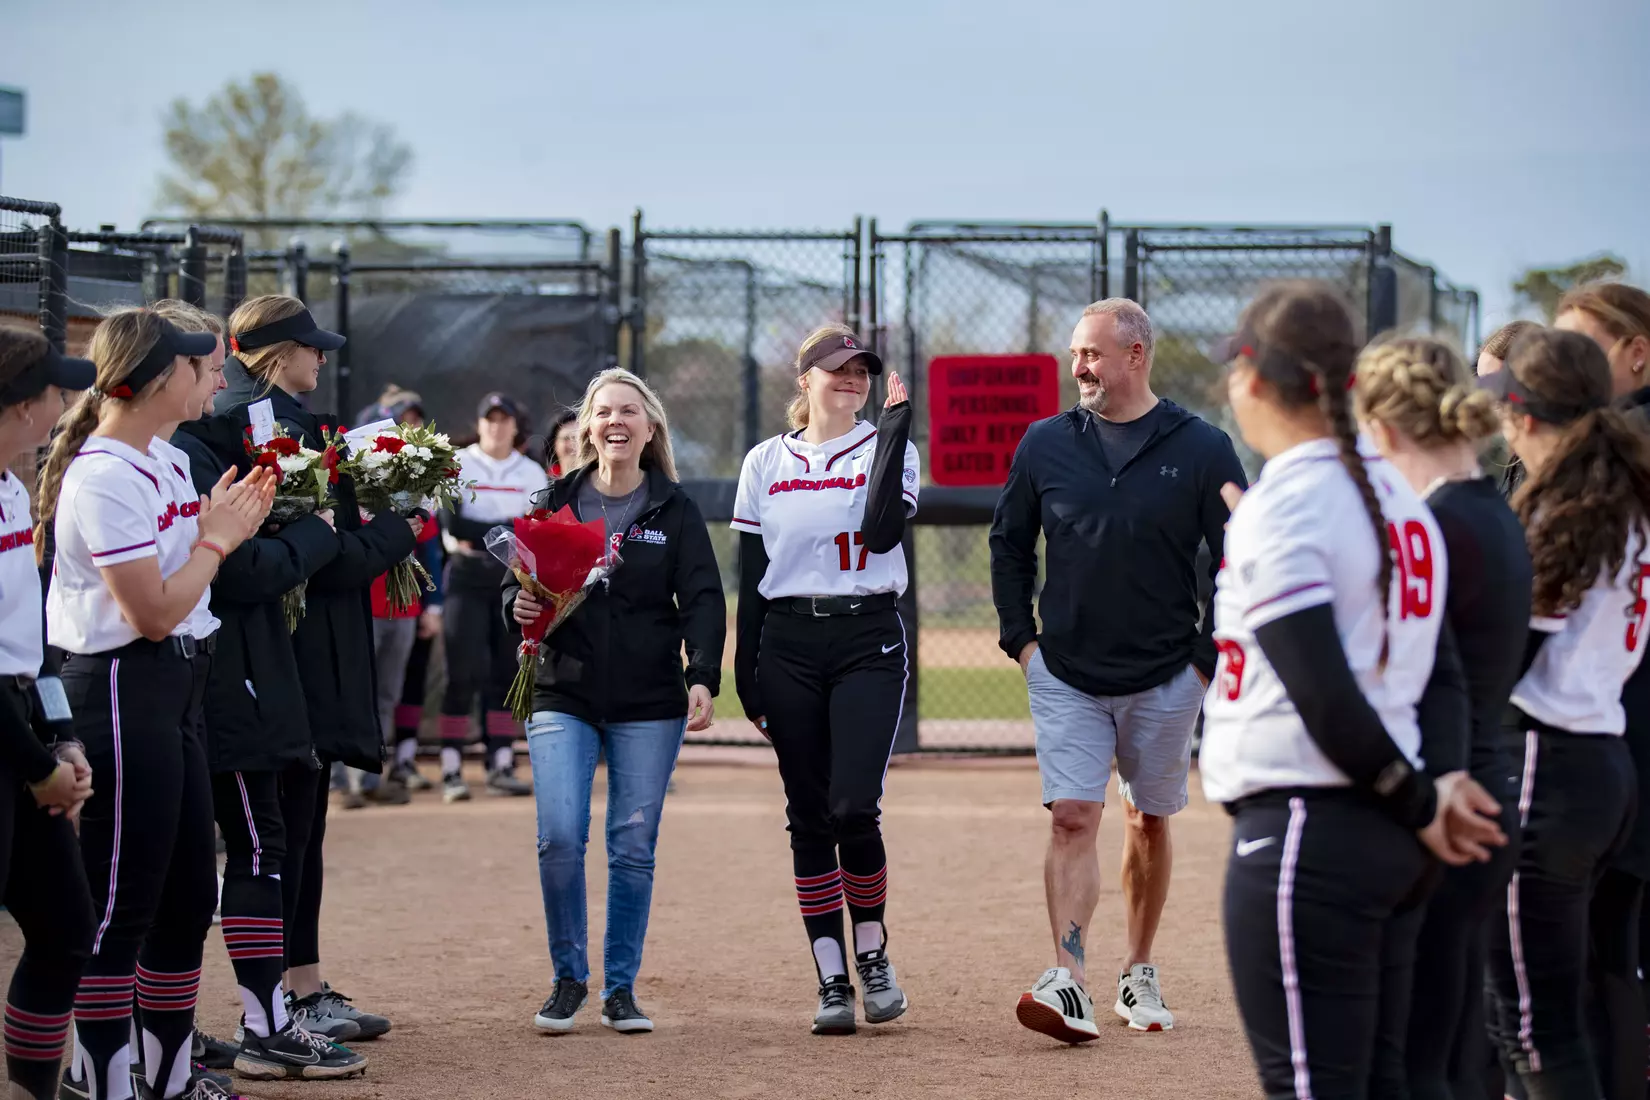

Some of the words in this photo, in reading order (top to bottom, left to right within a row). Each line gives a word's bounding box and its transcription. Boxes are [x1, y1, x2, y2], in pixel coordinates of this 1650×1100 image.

[948, 394, 1039, 415] PERSONNEL
[940, 424, 977, 444] ONLY
[943, 452, 995, 473] GATED
[769, 474, 866, 495] CARDINALS
[834, 531, 869, 571] 17
